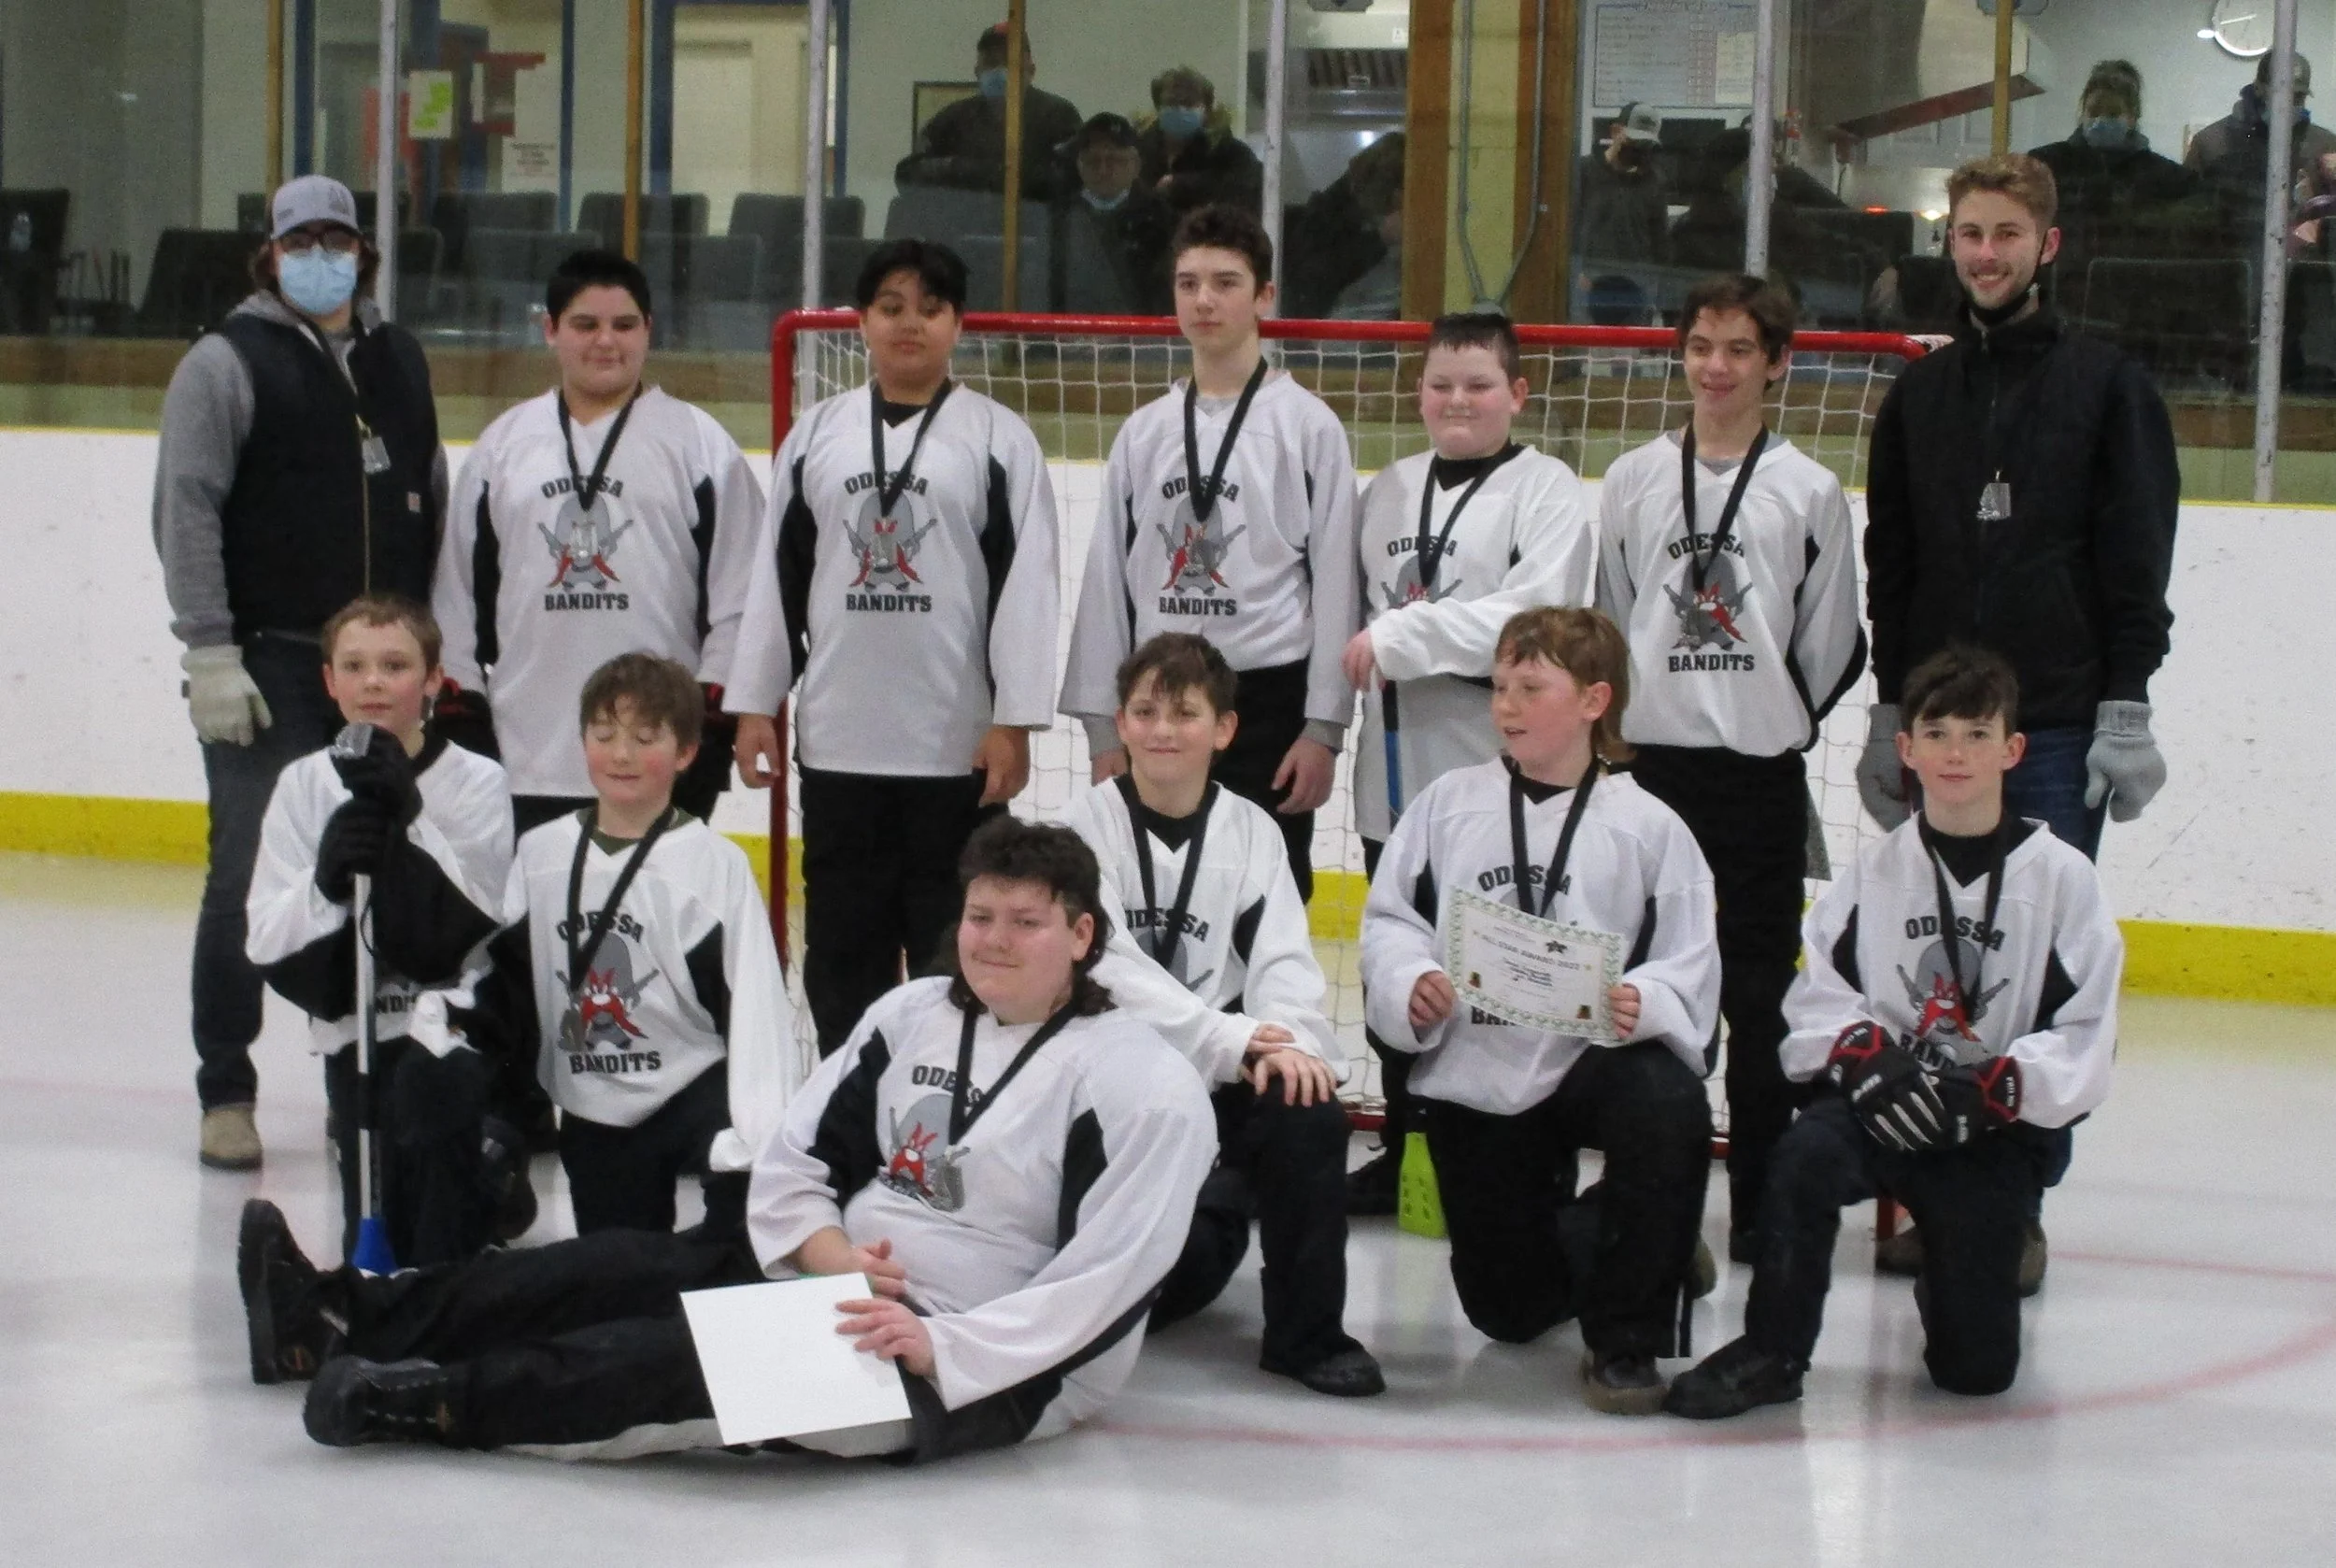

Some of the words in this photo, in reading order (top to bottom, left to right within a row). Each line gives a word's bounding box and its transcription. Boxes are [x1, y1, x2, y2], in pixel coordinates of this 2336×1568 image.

[541, 475, 623, 498] ODSA
[844, 472, 928, 495] ODSSA
[1162, 476, 1240, 502] ODSSA
[1387, 535, 1458, 557] ODSA
[1668, 533, 1745, 560] ODESA
[545, 593, 629, 611] BANDITS
[846, 594, 932, 612] BANDITS
[1159, 596, 1237, 616] BANDITS
[1669, 653, 1754, 673] BANDITS
[1478, 864, 1572, 895] ODSA
[1905, 916, 2006, 951] ODSSA
[568, 1050, 662, 1075] BANDITS
[912, 1064, 986, 1107] ODES
